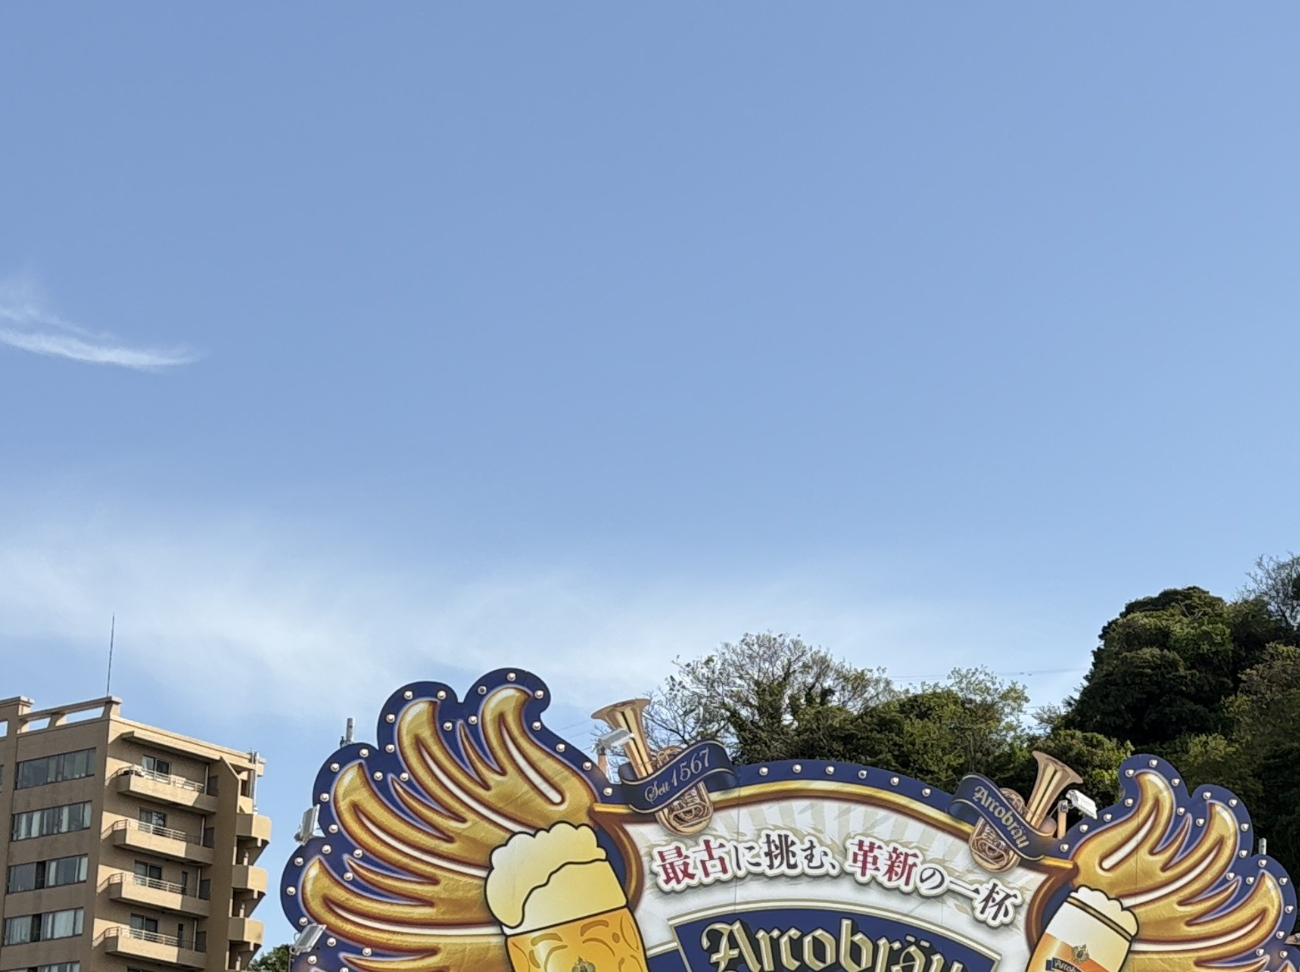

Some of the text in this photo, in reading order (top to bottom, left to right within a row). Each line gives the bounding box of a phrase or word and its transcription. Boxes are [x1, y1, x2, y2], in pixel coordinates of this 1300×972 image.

[671, 748, 710, 788] 1567
[972, 786, 1029, 848] Arcobräu
[657, 833, 1017, 921] 最古に挑む、革新の一杯
